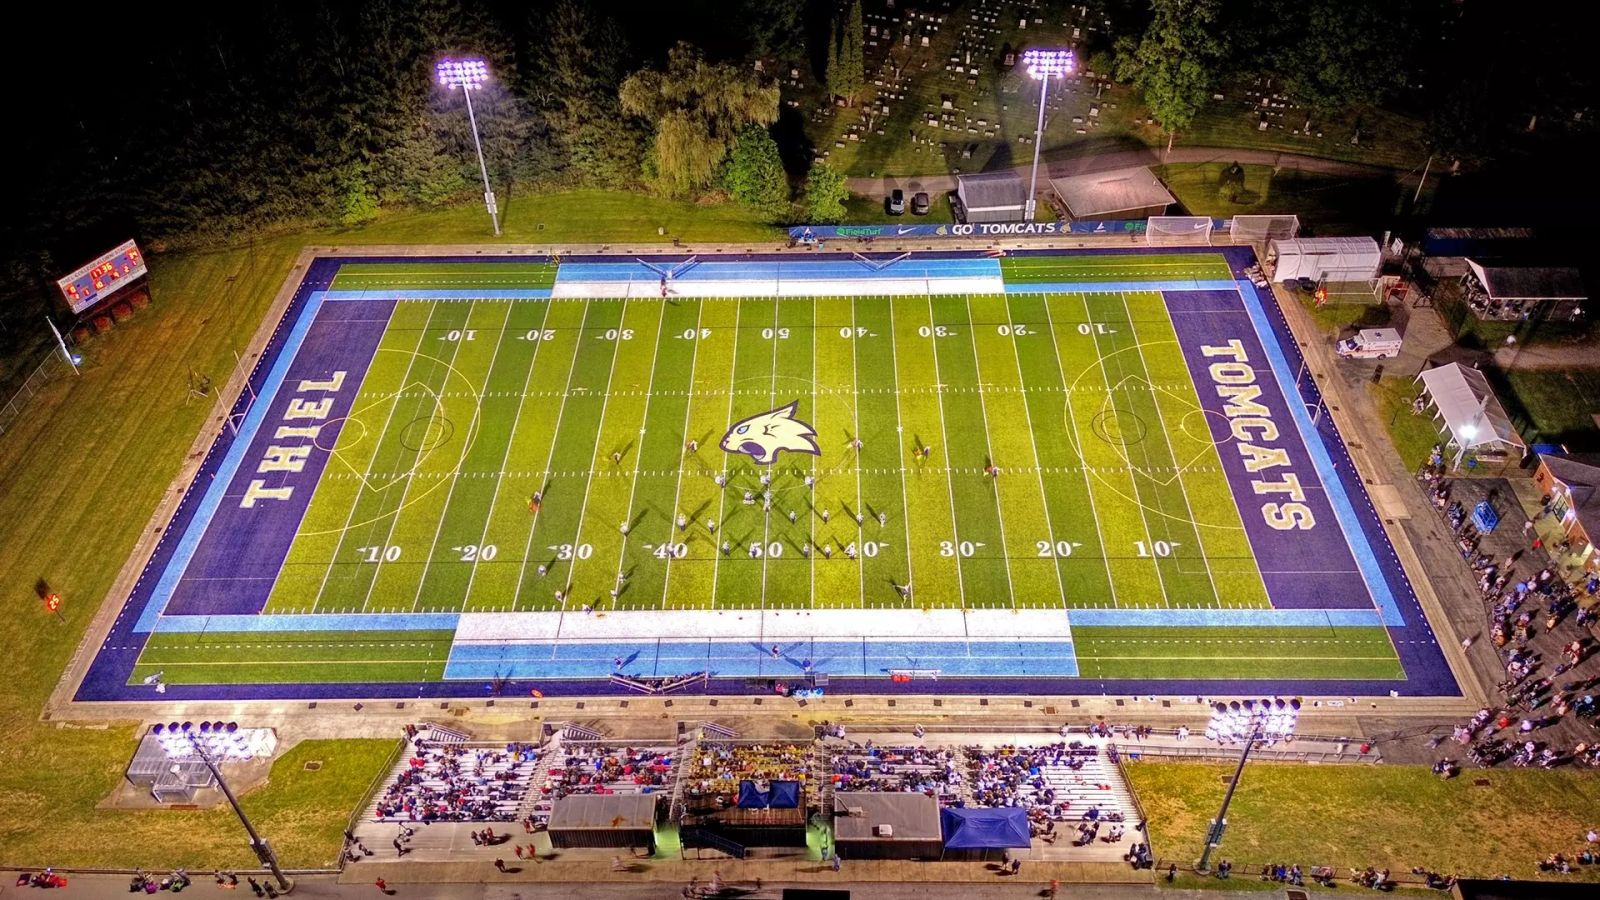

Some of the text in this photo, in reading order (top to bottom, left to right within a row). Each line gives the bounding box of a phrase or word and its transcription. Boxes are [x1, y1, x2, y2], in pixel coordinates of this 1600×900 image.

[845, 227, 881, 236] FieldTurf
[952, 222, 1056, 236] GO TOMCATS
[447, 329, 477, 341] 10
[526, 329, 556, 341] 20
[605, 328, 635, 340] 30
[683, 328, 713, 340] 40
[762, 327, 790, 339] 50
[839, 326, 868, 339] 40
[918, 325, 947, 337] 30
[997, 324, 1027, 336] 20
[1077, 323, 1108, 335] 10
[239, 370, 347, 508] THIEL
[1200, 338, 1316, 530] TOMCATS
[364, 545, 402, 562] 10
[460, 544, 497, 561] 20
[557, 543, 593, 560] 30
[653, 542, 688, 559] 40
[939, 540, 975, 557] 30
[1035, 540, 1072, 557] 20
[1132, 540, 1170, 557] 10
